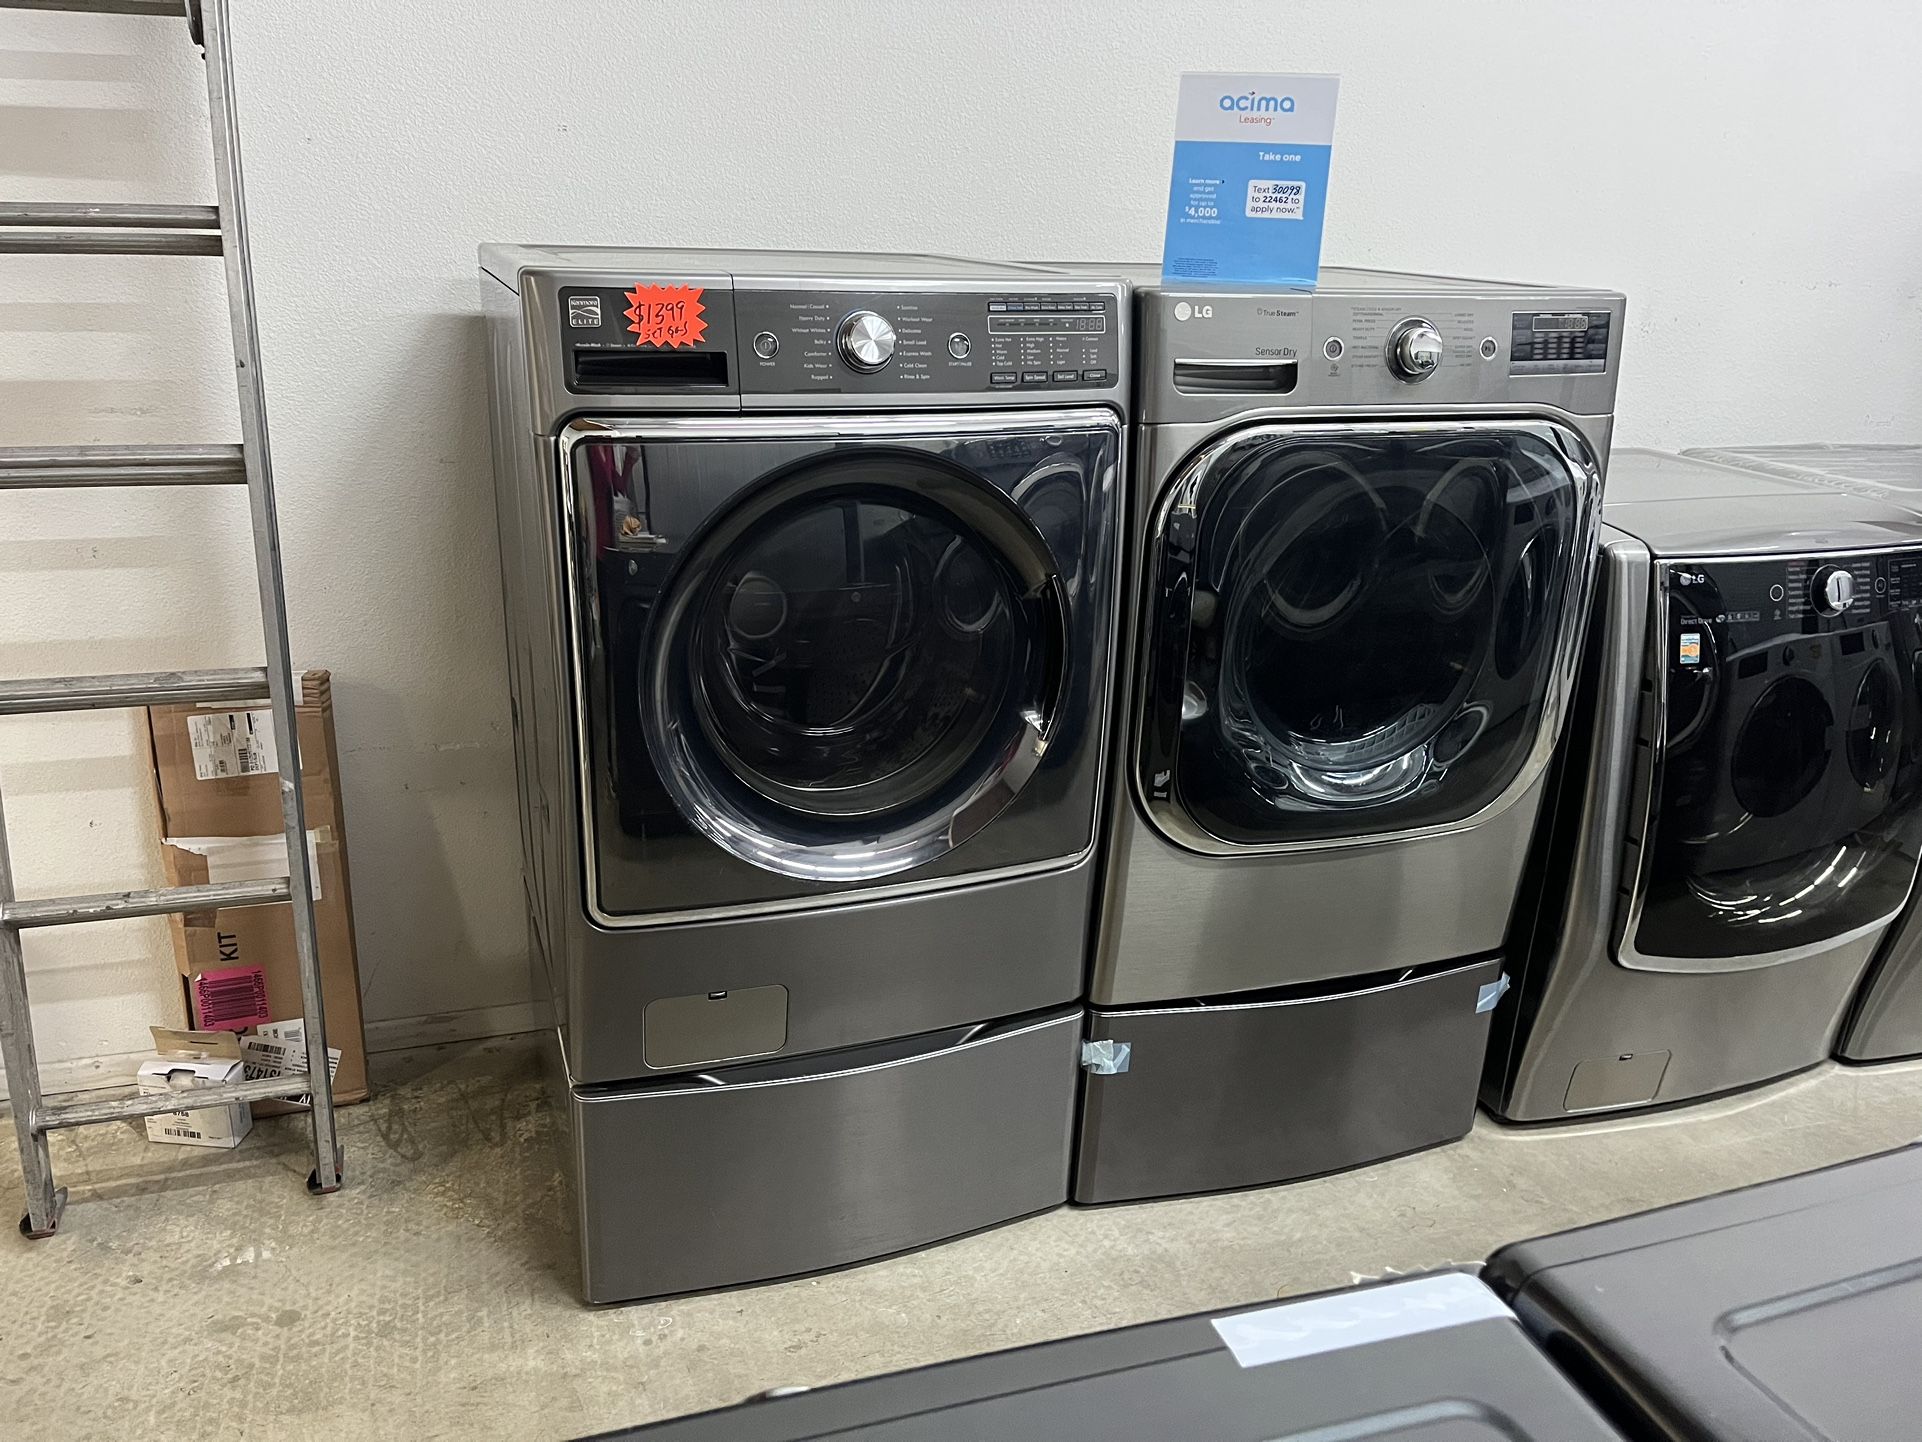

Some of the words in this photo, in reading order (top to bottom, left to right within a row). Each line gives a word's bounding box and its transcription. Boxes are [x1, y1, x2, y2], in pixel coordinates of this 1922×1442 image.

[1219, 91, 1295, 112] acima
[1259, 152, 1281, 161] Take
[1283, 154, 1301, 162] one
[1253, 185, 1270, 194] Text
[1263, 196, 1289, 204] 22462
[1185, 205, 1218, 218] $4,000
[1250, 205, 1275, 215] apply
[634, 300, 686, 332] $1399
[1194, 306, 1213, 318] LG
[573, 318, 600, 326] ELITE
[217, 932, 239, 962] KIT
